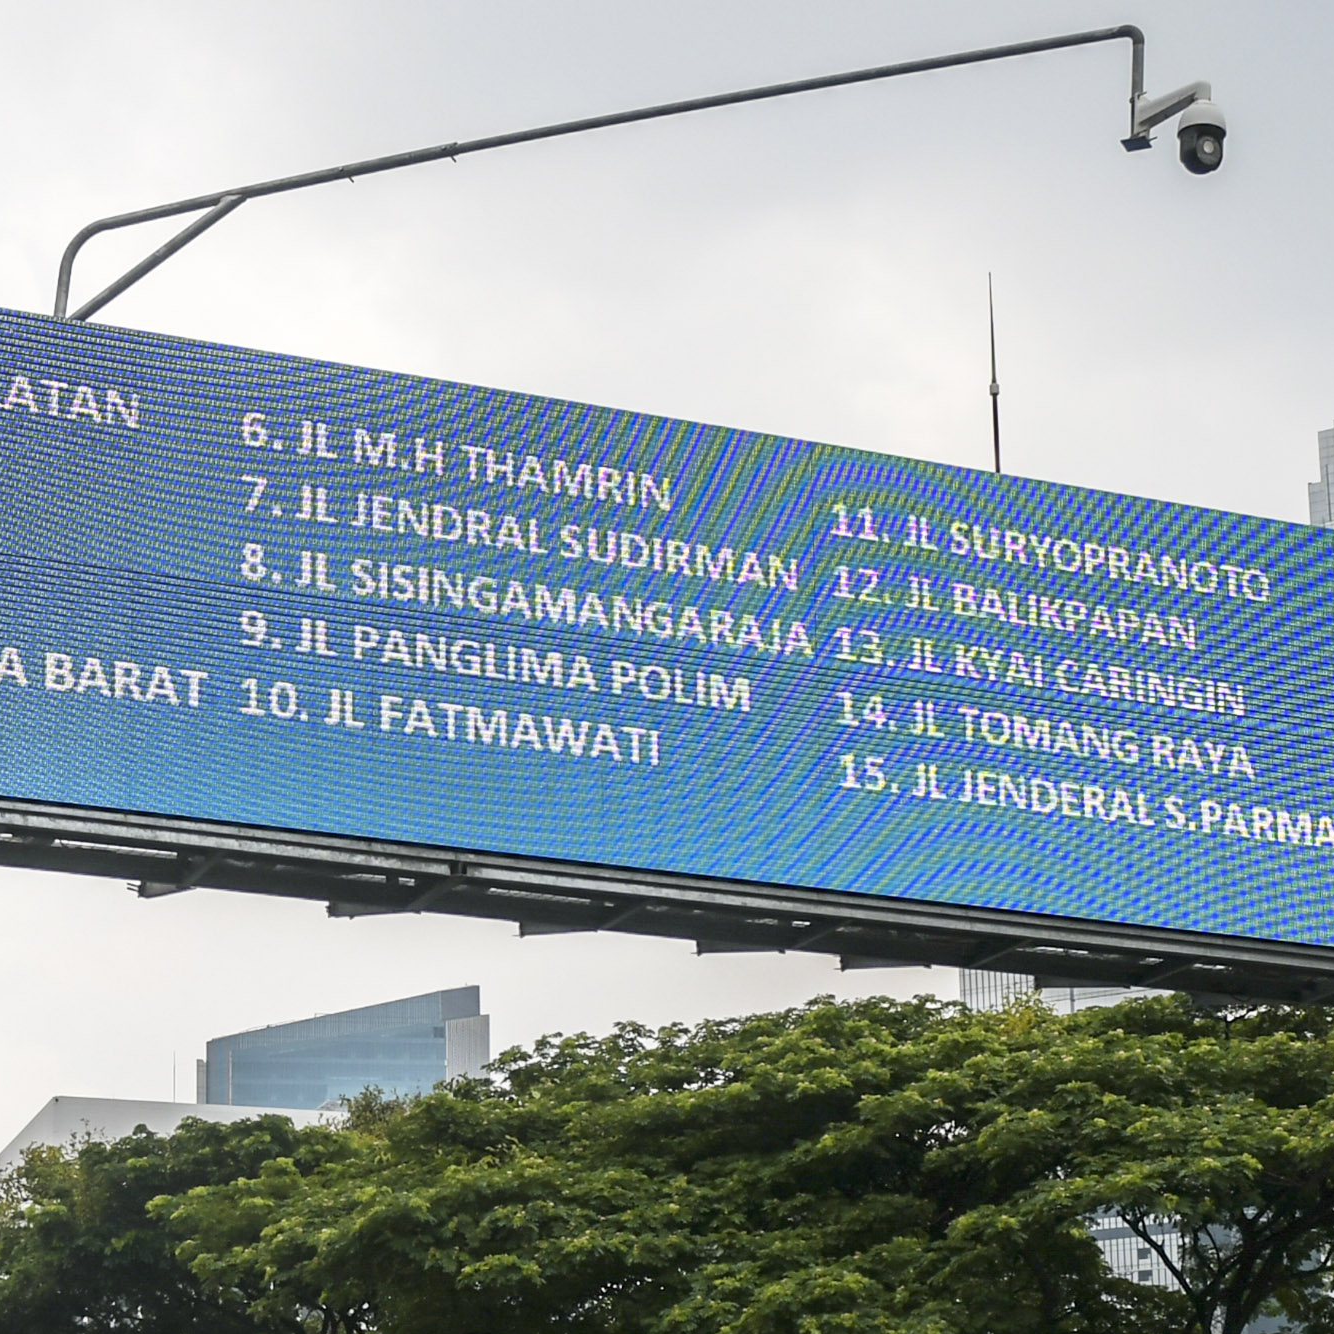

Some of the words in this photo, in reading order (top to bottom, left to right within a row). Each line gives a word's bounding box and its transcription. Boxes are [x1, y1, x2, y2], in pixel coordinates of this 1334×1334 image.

[242, 411, 283, 452] 6.
[295, 418, 338, 460] JL
[354, 428, 445, 477] M.H
[458, 444, 671, 512] THAMRIN
[241, 475, 281, 518] 7.
[295, 483, 338, 525] JL
[350, 492, 548, 556] JENDRAL
[559, 523, 798, 592] SUDIRMAN
[830, 503, 890, 544] 11.
[903, 513, 938, 552] JL
[950, 521, 1270, 602] SURYOPRANOTO
[240, 542, 282, 584] 8.
[295, 550, 337, 591] JL
[352, 557, 814, 657] SISINGAMANGARAJA
[832, 565, 893, 605] 12.
[905, 575, 941, 612] JL
[952, 582, 1196, 650] BALIKPAPAN
[44, 651, 209, 709] BARAT
[239, 609, 283, 651] 9.
[295, 617, 338, 659] JL
[353, 624, 599, 694] PANGLIMA
[612, 659, 751, 714] POLIM
[908, 636, 943, 674] JL
[239, 677, 309, 722] 10.
[324, 687, 365, 730] JL
[380, 694, 662, 767] FATMAWATI
[837, 690, 898, 732] 14.
[910, 700, 946, 738] JL
[959, 706, 1139, 764] TOMANG
[1151, 736, 1256, 781] RAYA
[839, 753, 900, 796] 15.
[911, 762, 947, 802] JL
[959, 769, 1155, 826] JENDERAL
